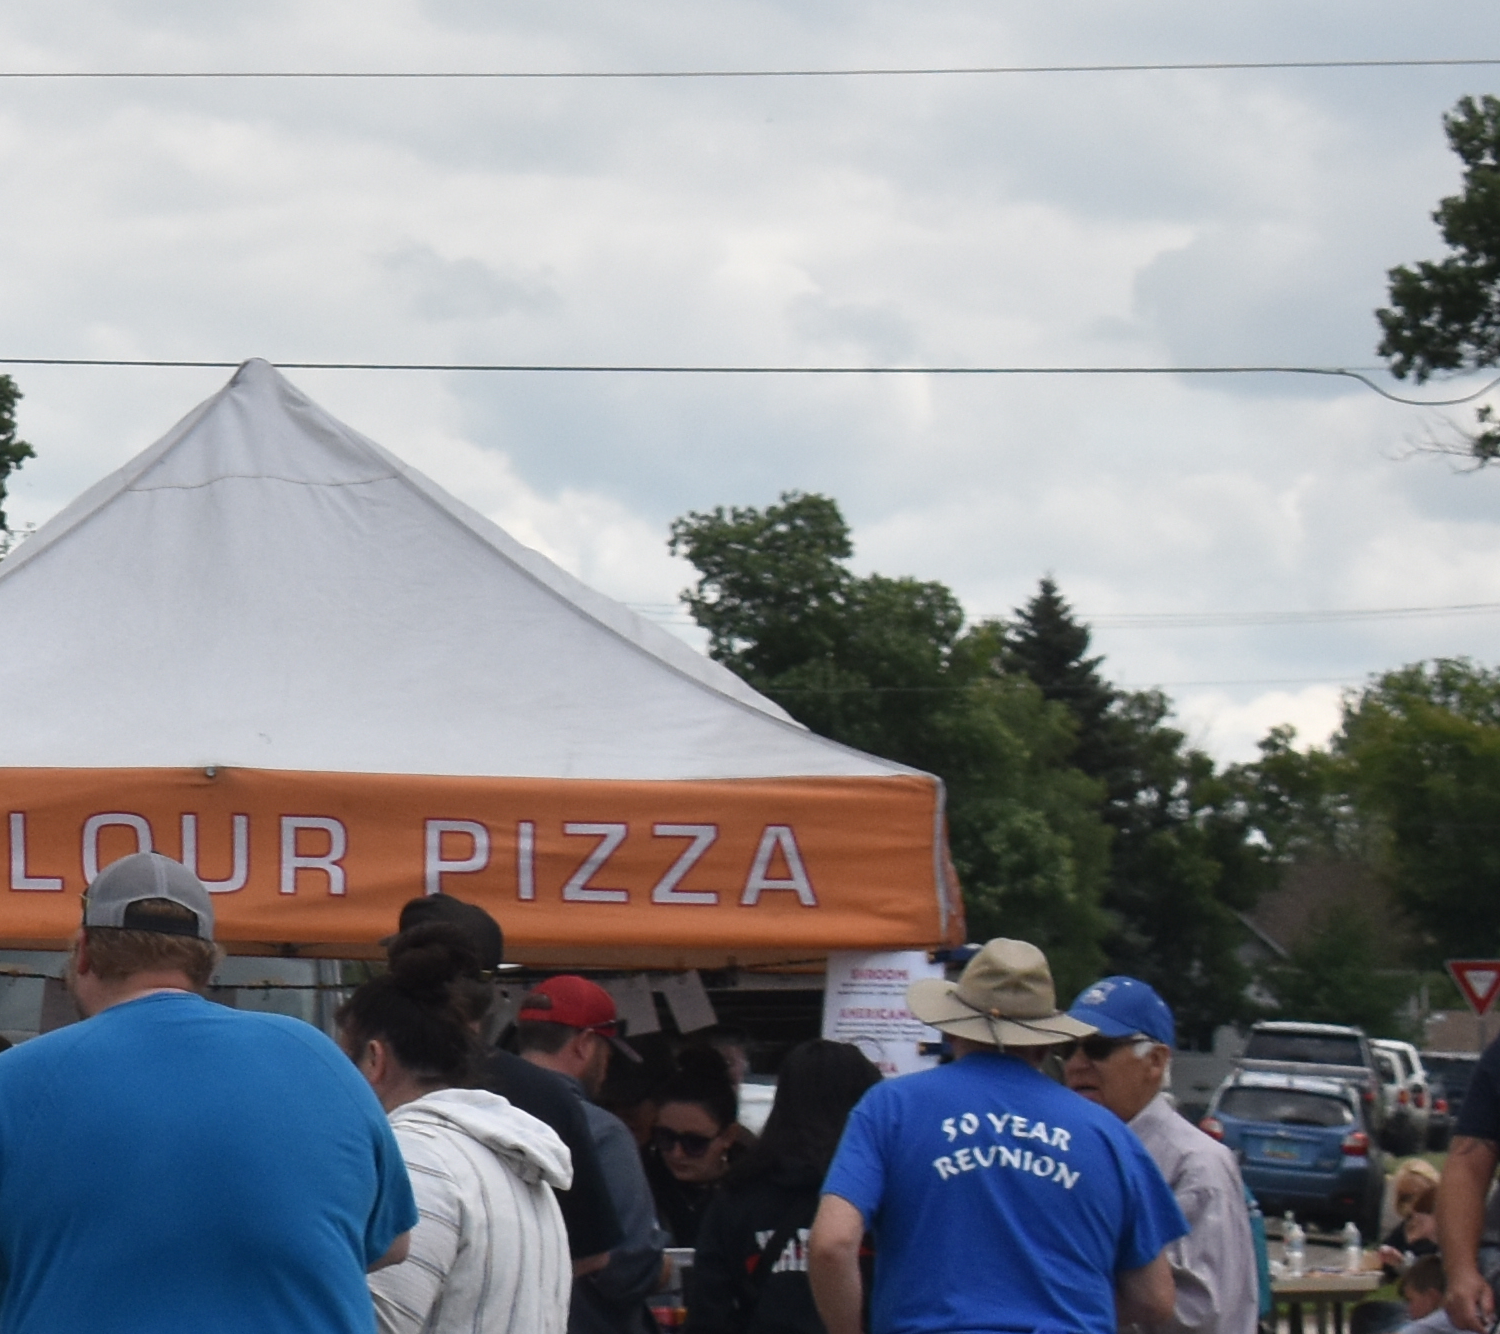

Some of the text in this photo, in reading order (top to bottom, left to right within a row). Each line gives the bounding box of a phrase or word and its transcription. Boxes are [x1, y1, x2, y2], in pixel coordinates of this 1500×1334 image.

[424, 818, 818, 909] PIZZA
[941, 1112, 1072, 1152] 50 YEAR
[932, 1145, 1082, 1190] REUNION
